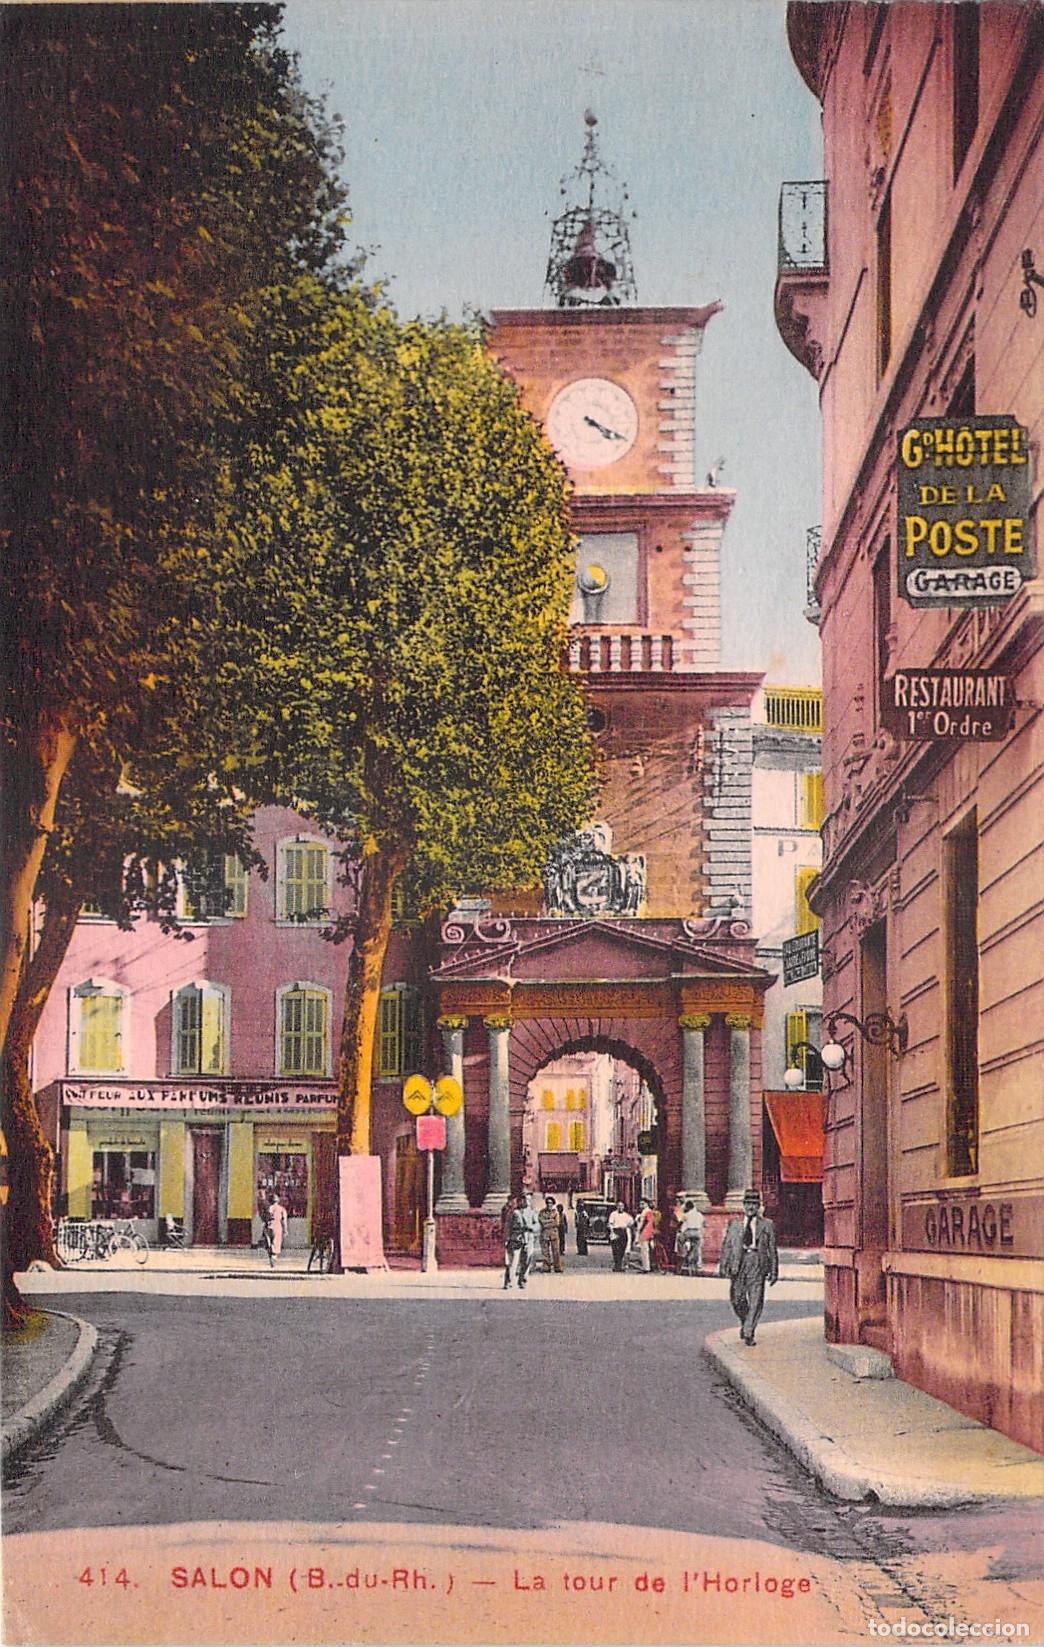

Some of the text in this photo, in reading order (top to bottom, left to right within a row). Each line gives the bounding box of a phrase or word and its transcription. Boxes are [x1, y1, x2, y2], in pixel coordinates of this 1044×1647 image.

[919, 483, 1006, 505] DE LA
[905, 515, 1023, 557] POSTE
[914, 570, 1014, 592] GARAGE
[894, 673, 1006, 707] RESTAURANT
[908, 710, 991, 735] 1er Ordre
[925, 1203, 1014, 1246] GARAGE
